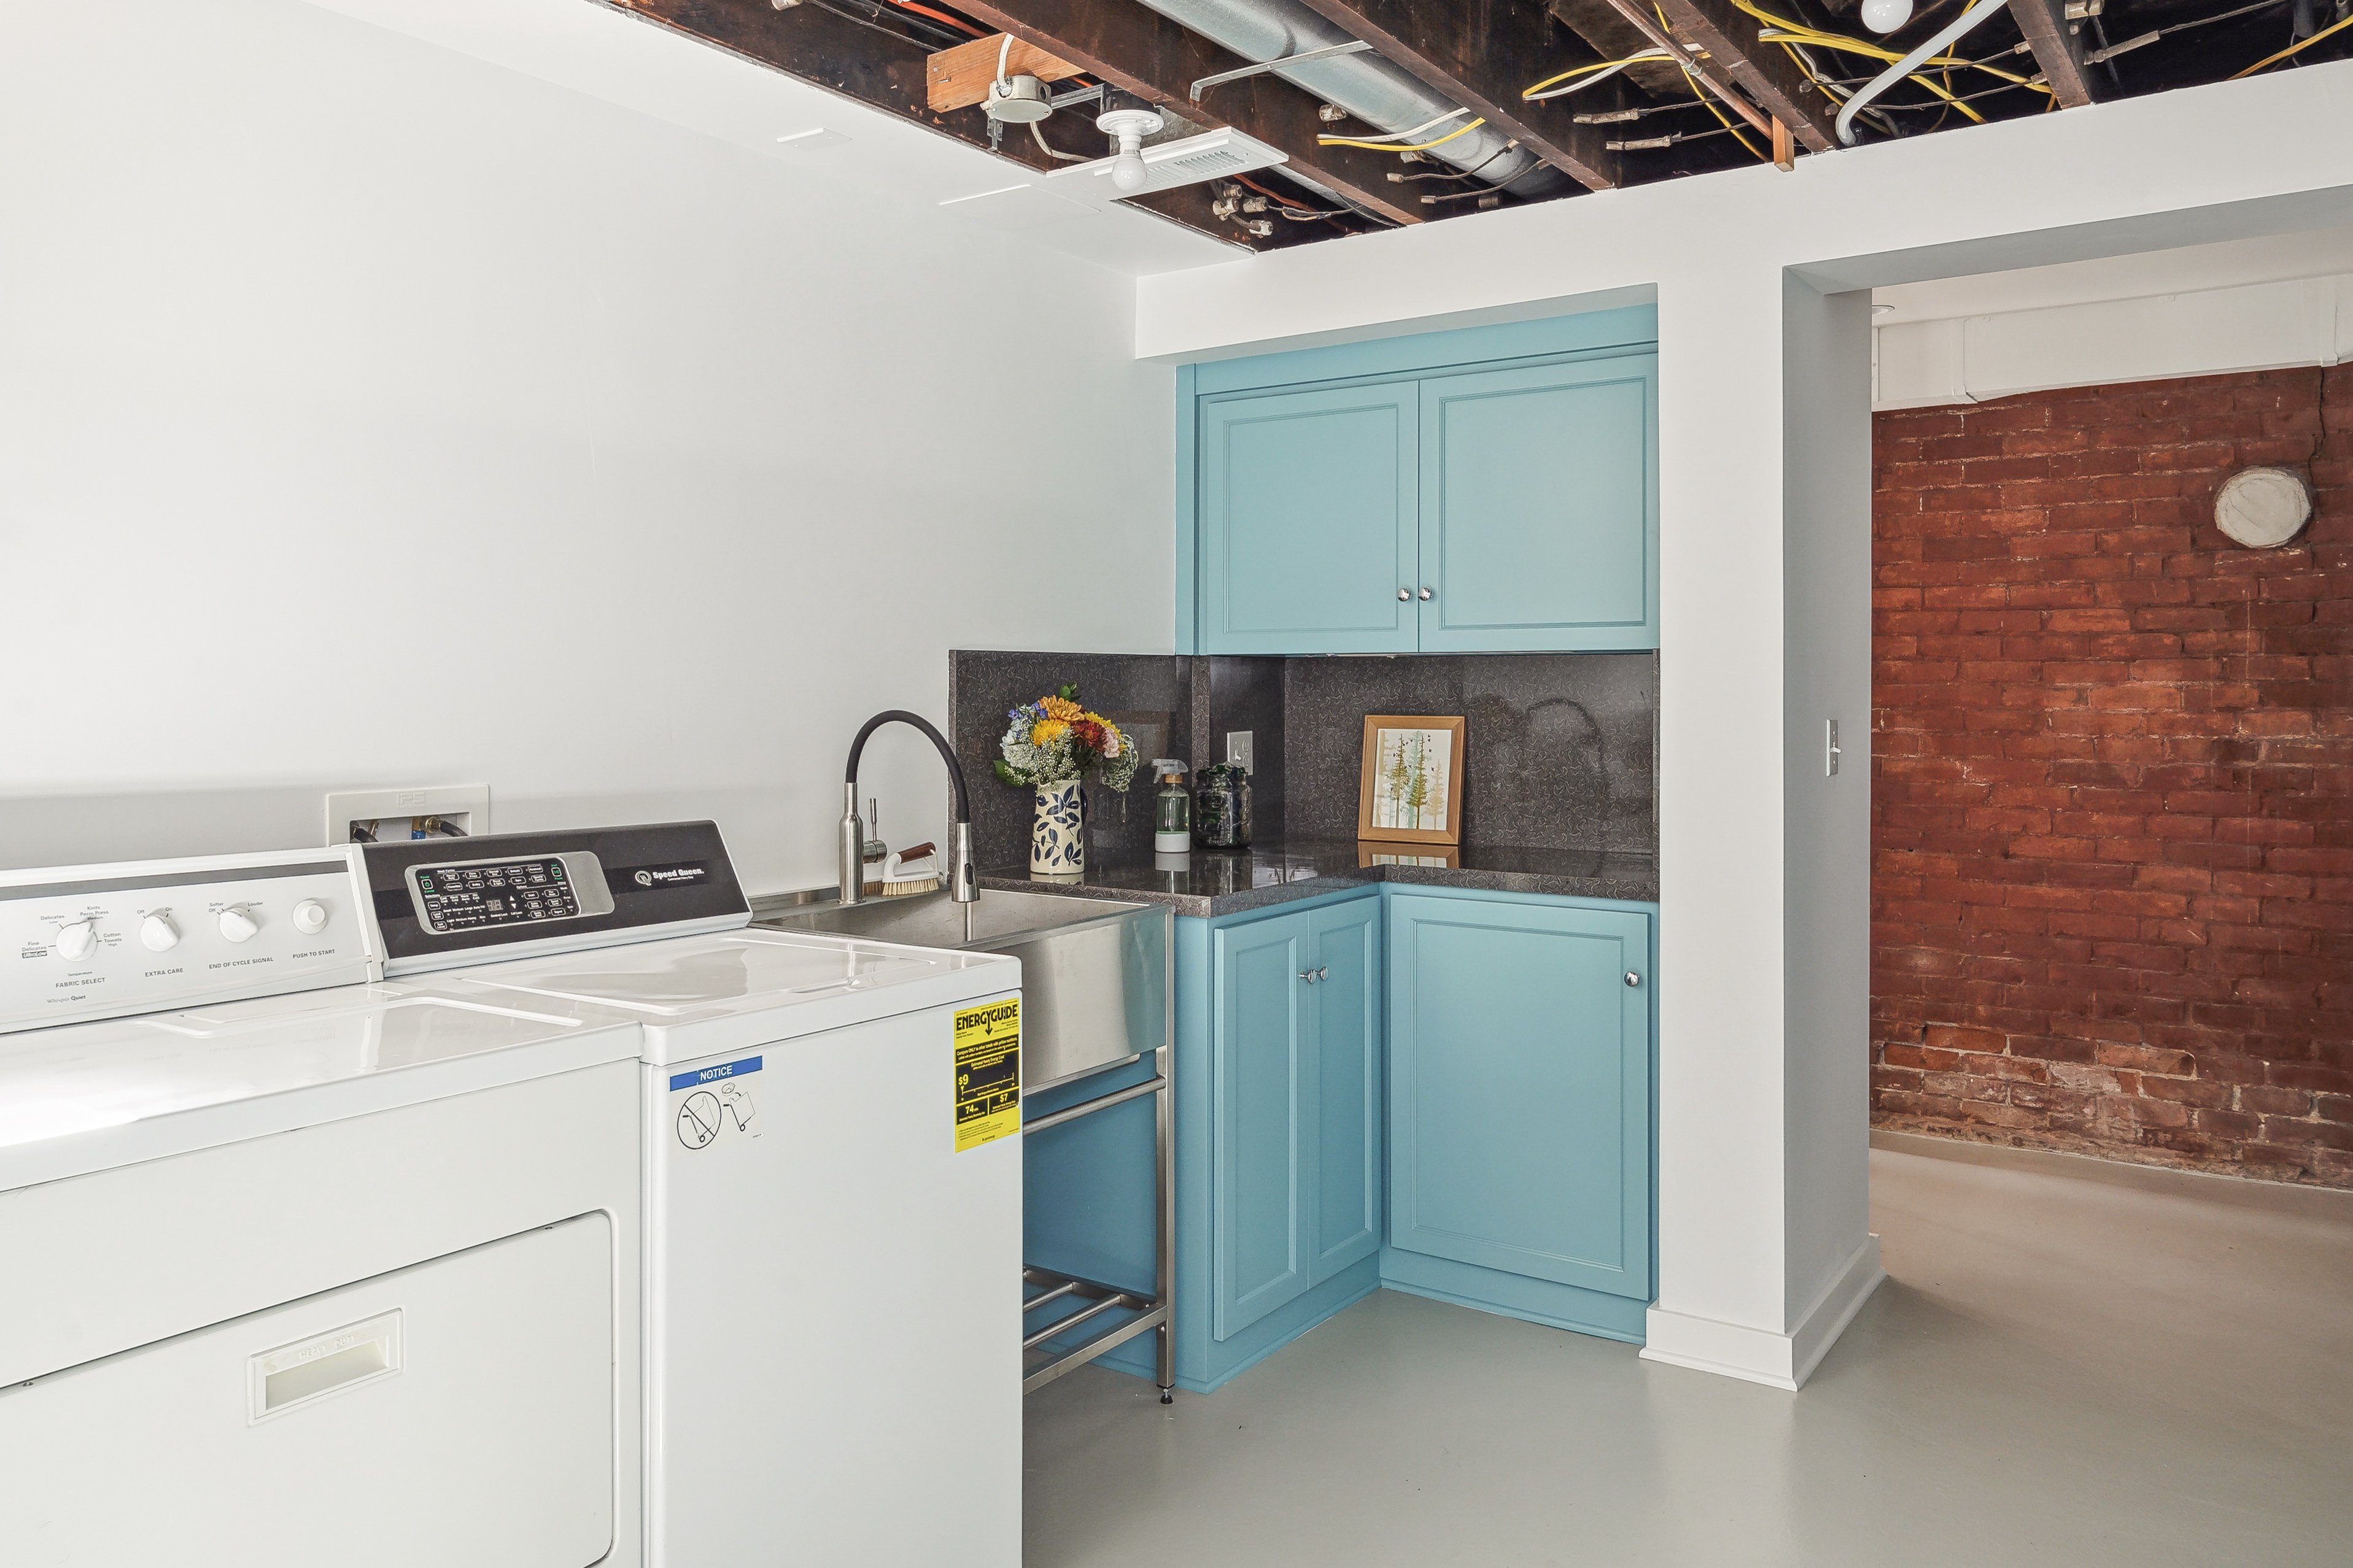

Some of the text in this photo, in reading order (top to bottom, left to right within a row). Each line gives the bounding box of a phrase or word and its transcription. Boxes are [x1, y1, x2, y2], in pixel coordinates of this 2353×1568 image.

[396, 792, 427, 805] IPS
[653, 870, 678, 879] Speed
[55, 977, 106, 989] FABRIC SELECT
[956, 1004, 1018, 1032] ENERGYGUIDE
[700, 1065, 733, 1081] NOTICE
[958, 1074, 969, 1086] $9
[999, 1093, 1008, 1103] $7
[965, 1104, 974, 1114] 74
